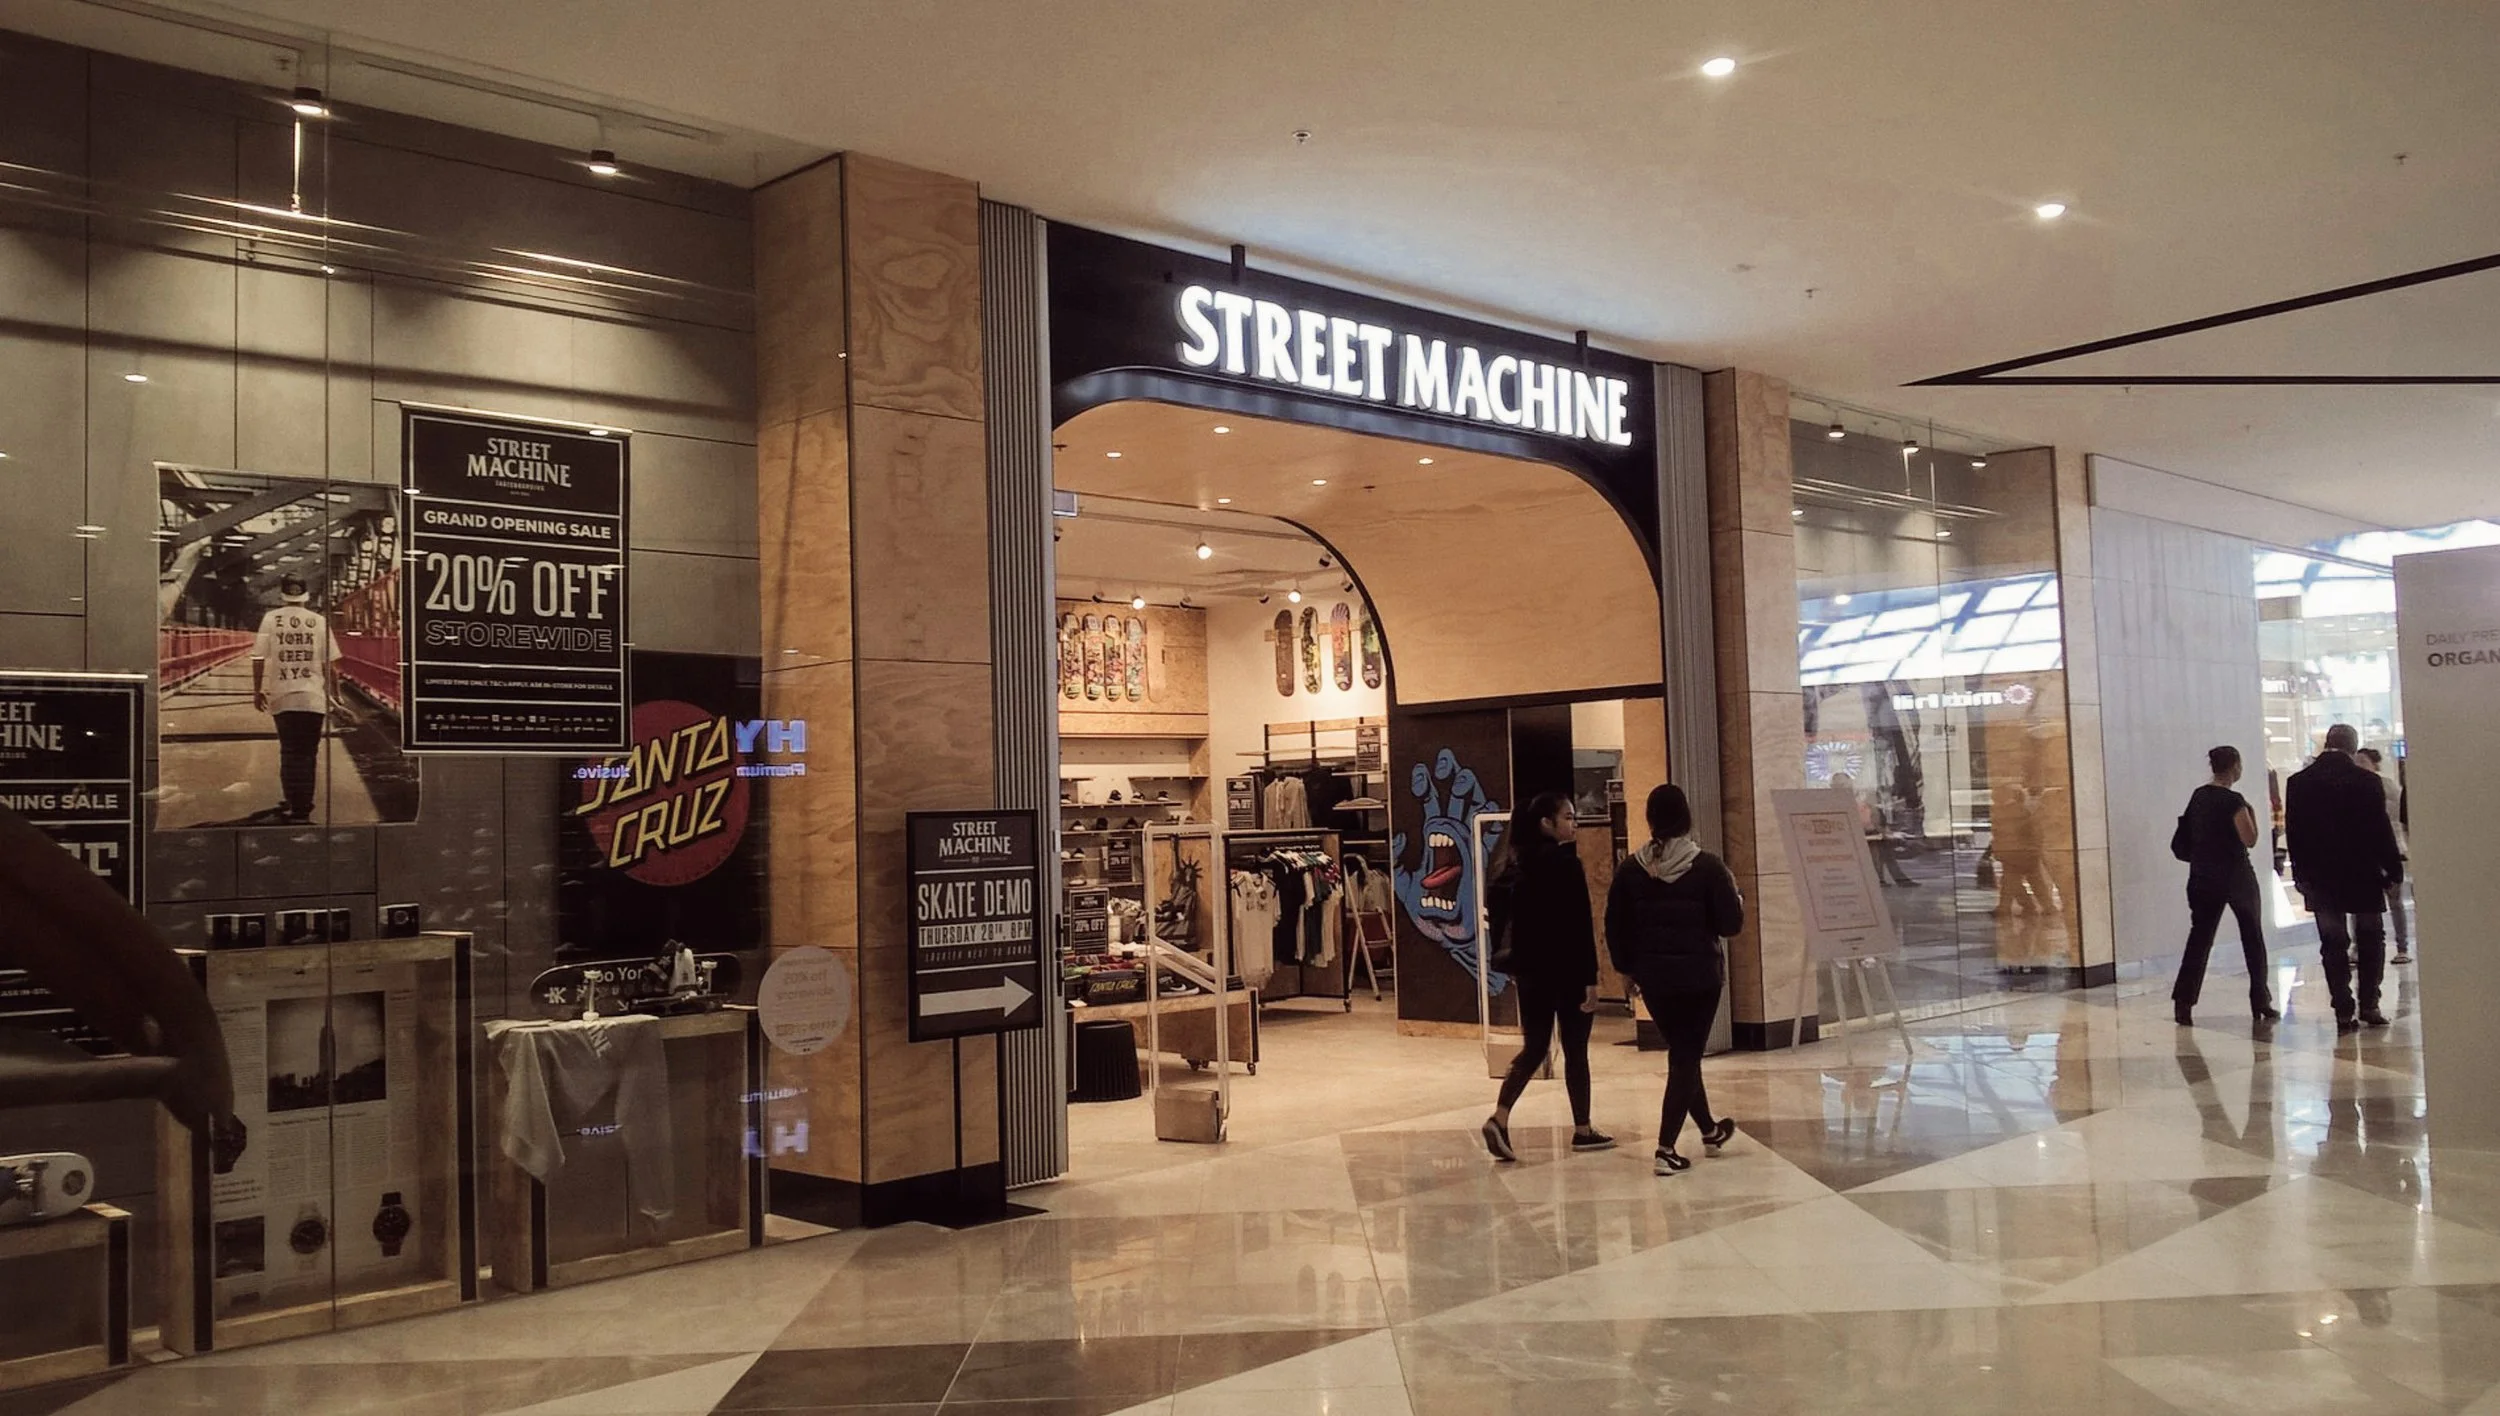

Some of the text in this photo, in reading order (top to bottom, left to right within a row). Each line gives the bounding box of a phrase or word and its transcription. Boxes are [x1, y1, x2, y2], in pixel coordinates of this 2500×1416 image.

[1175, 285, 1633, 447] STREET MACHINE
[487, 437, 551, 461] STREET
[467, 454, 572, 488] MACHINE
[423, 510, 612, 539] GRAND OPENING SALE
[425, 552, 614, 619] 20% OFF
[276, 633, 314, 645] YORK
[425, 620, 613, 652] STOREWIDE
[2426, 633, 2467, 645] DAILY
[576, 715, 730, 816] SANTA
[61, 794, 119, 809] SALE
[609, 777, 730, 868] CRUZ
[952, 821, 997, 837] STREET
[938, 836, 1013, 858] MACHINE
[918, 878, 1032, 921] SKATE DEMO
[920, 925, 977, 946] THURSDAY
